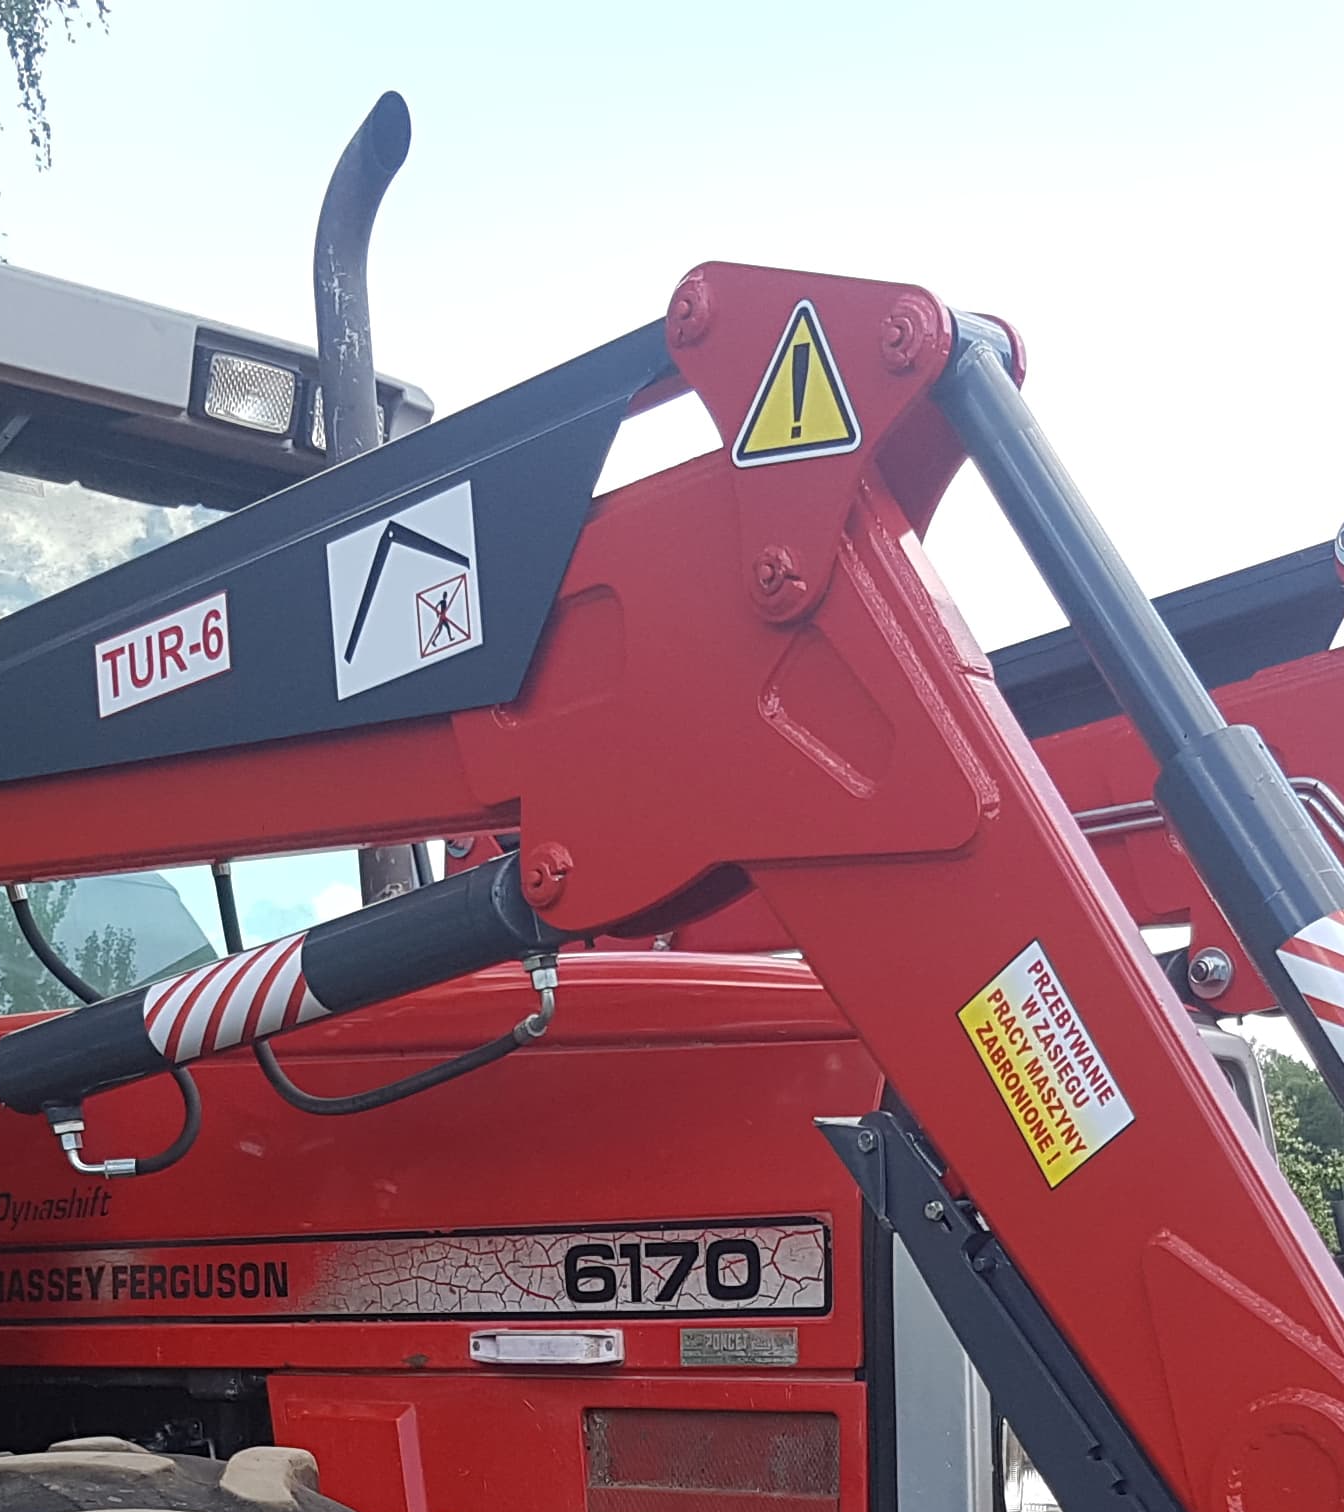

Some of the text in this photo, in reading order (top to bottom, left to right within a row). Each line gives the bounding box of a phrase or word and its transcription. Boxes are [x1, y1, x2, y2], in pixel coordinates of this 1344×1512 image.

[101, 608, 224, 698] TUR-6
[975, 1020, 1055, 1154] ZABRONIONE
[986, 988, 1088, 1155] PRACY MASZYNY
[1021, 993, 1090, 1109] W ZASIĘGU
[1027, 959, 1115, 1107] PRZEBYWANIE
[112, 1261, 289, 1300] FERGUSON
[565, 1239, 761, 1304] 6170
